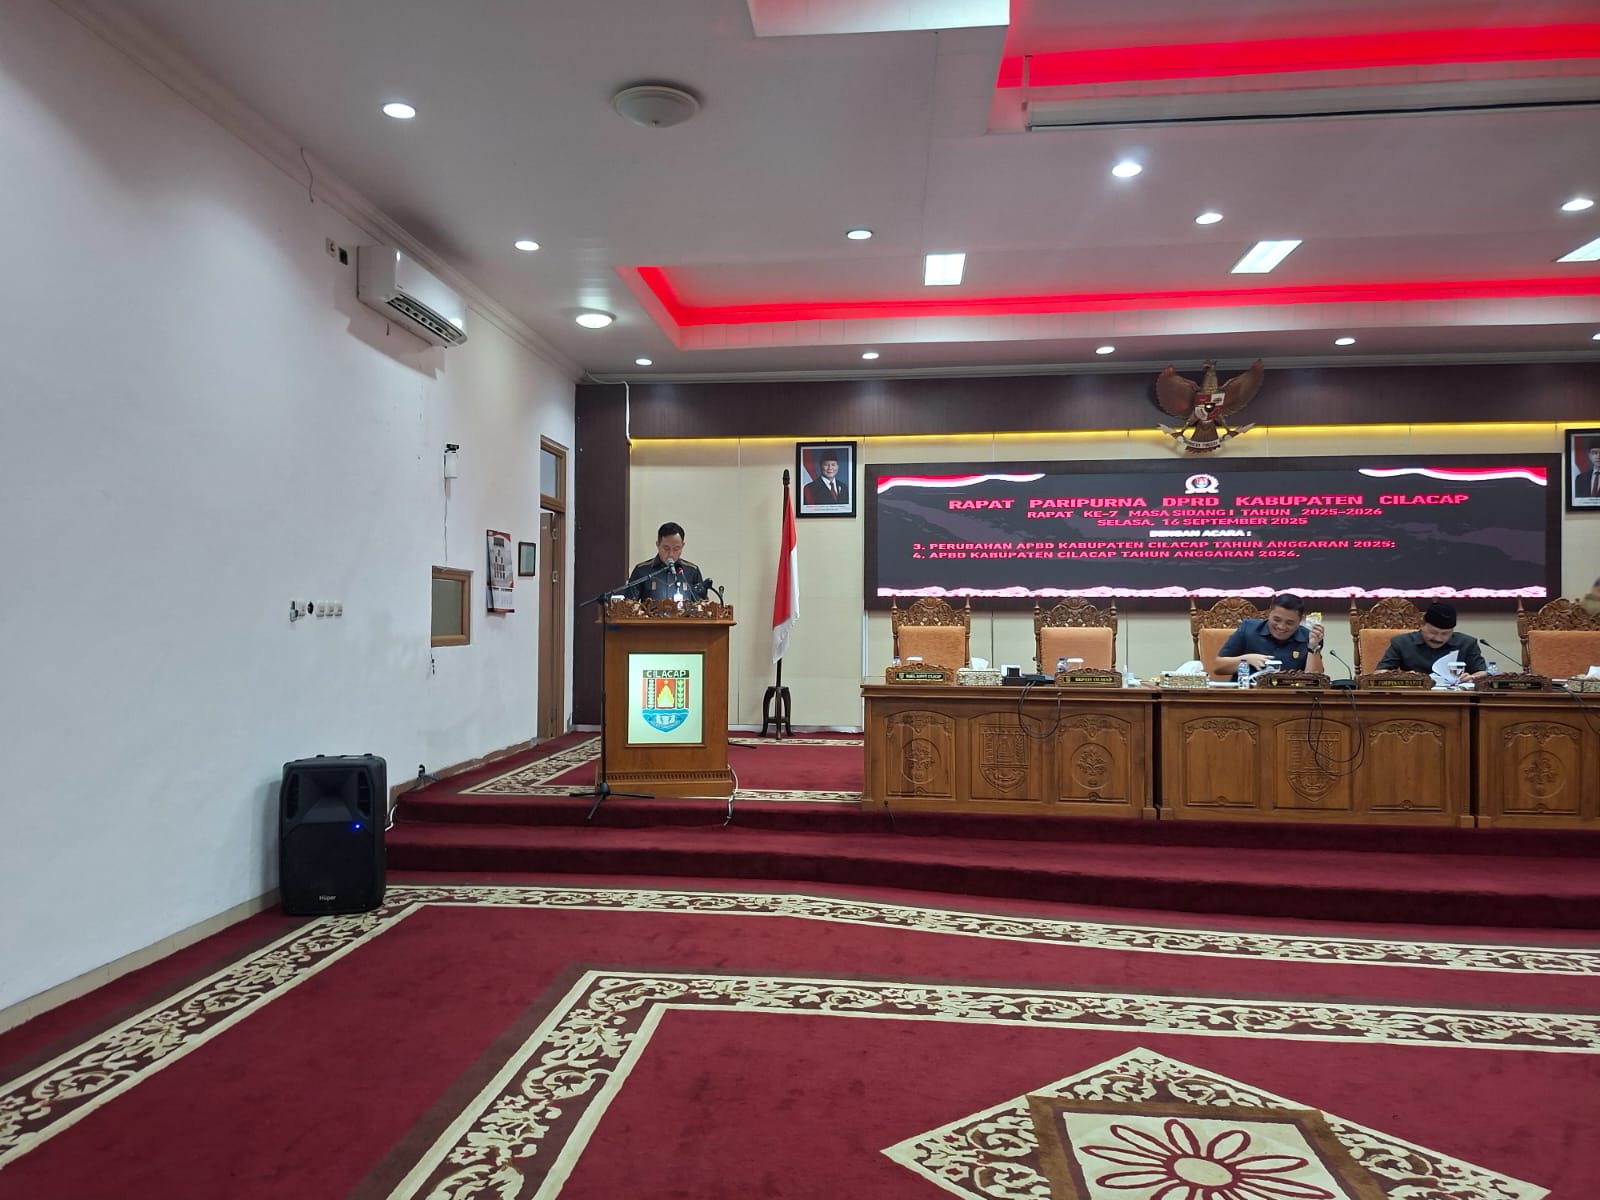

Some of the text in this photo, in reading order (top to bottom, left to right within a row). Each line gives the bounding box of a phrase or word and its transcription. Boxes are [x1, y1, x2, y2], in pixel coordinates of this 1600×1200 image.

[949, 493, 1469, 510] RAPAT PARIPURNA DPRD KABUPATEN CILACAP
[1027, 510, 1073, 518] RAPAT
[1083, 509, 1118, 518] KE-7
[1128, 510, 1170, 518] MASA
[1172, 509, 1225, 517] SIDANG
[1240, 508, 1290, 516] TAHUN
[1301, 507, 1383, 516] 2025-2026
[1162, 518, 1180, 526] 16
[1183, 517, 1268, 526] SEPTEMBER
[1270, 517, 1308, 525] 2025
[1202, 529, 1246, 537] ACARA
[929, 542, 1013, 550] PERUBAHAN
[1015, 542, 1055, 550] APBD
[1058, 541, 1143, 549] KABUPATEN
[1147, 541, 1209, 549] CILACAP
[1213, 540, 1263, 548] TAHUN
[1266, 540, 1349, 548] ANGGARAN
[929, 551, 967, 559] APBD
[969, 551, 1053, 559] KABUPATEN
[1056, 550, 1117, 558] CILACAP
[1120, 550, 1171, 558] TAHUN
[1173, 549, 1254, 558] ANGGARAN
[646, 670, 687, 678] CILACAP
